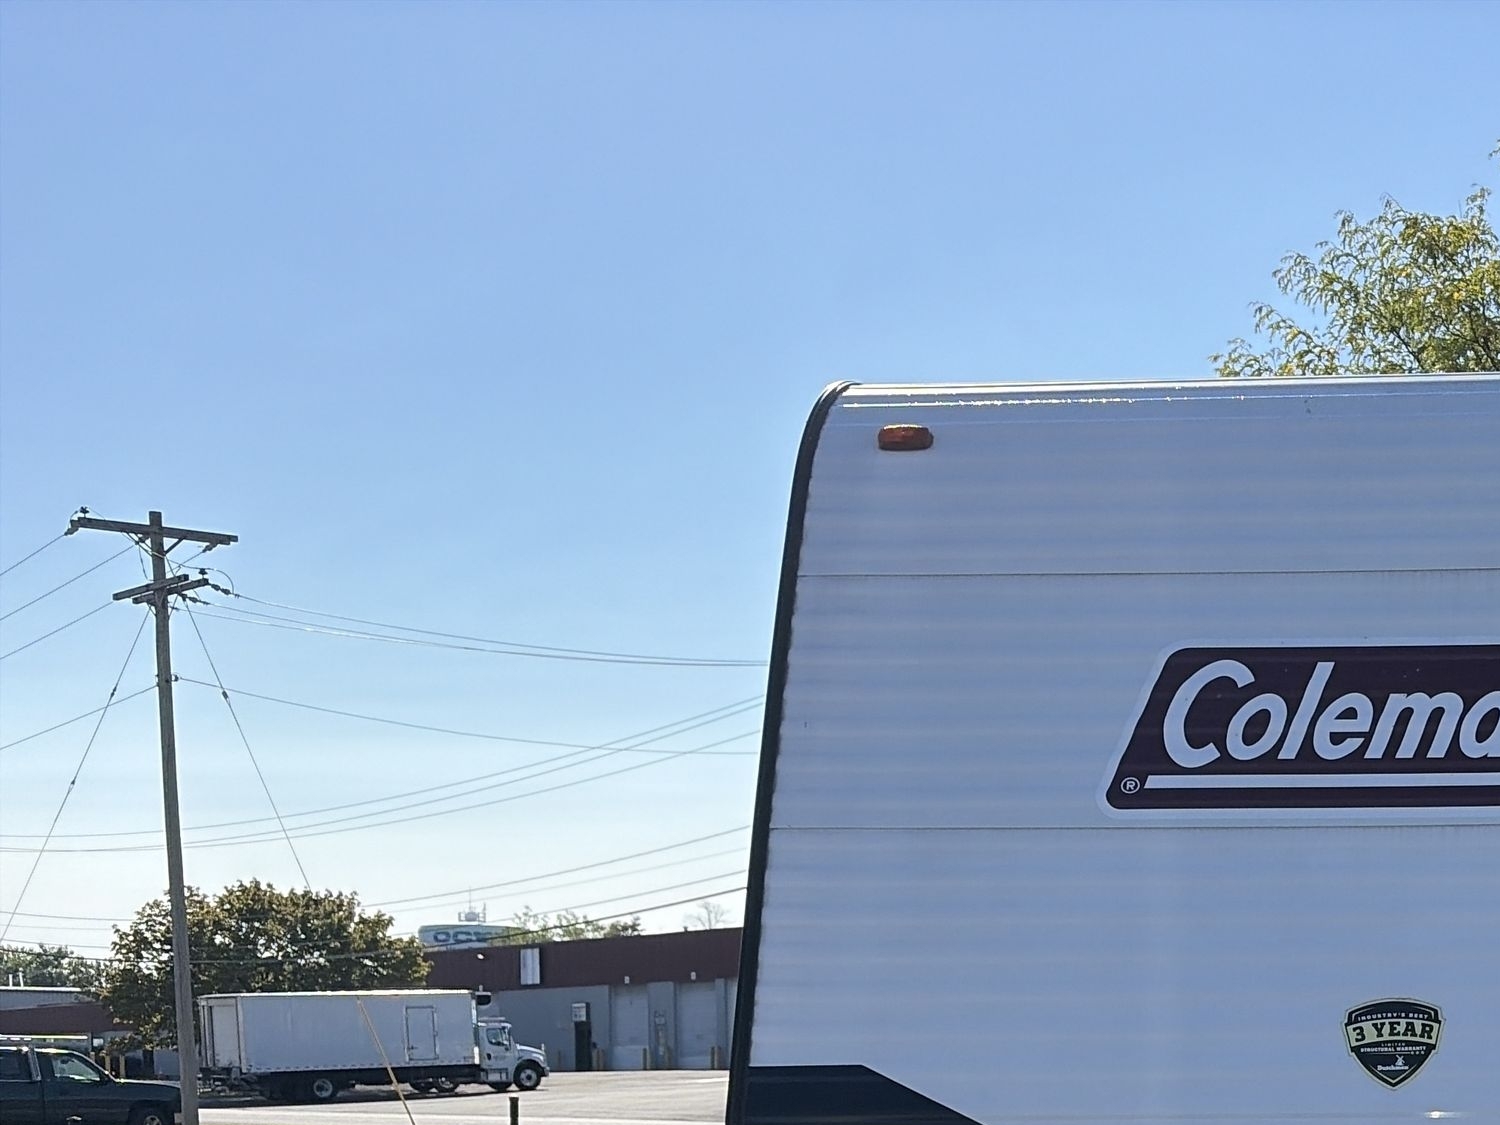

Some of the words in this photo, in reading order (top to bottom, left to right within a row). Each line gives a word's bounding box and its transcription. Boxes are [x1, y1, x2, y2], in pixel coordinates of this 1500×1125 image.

[1358, 1012, 1406, 1021] INDUSTRY'S
[1352, 1026, 1366, 1042] 3
[1372, 1021, 1433, 1040] YEAR
